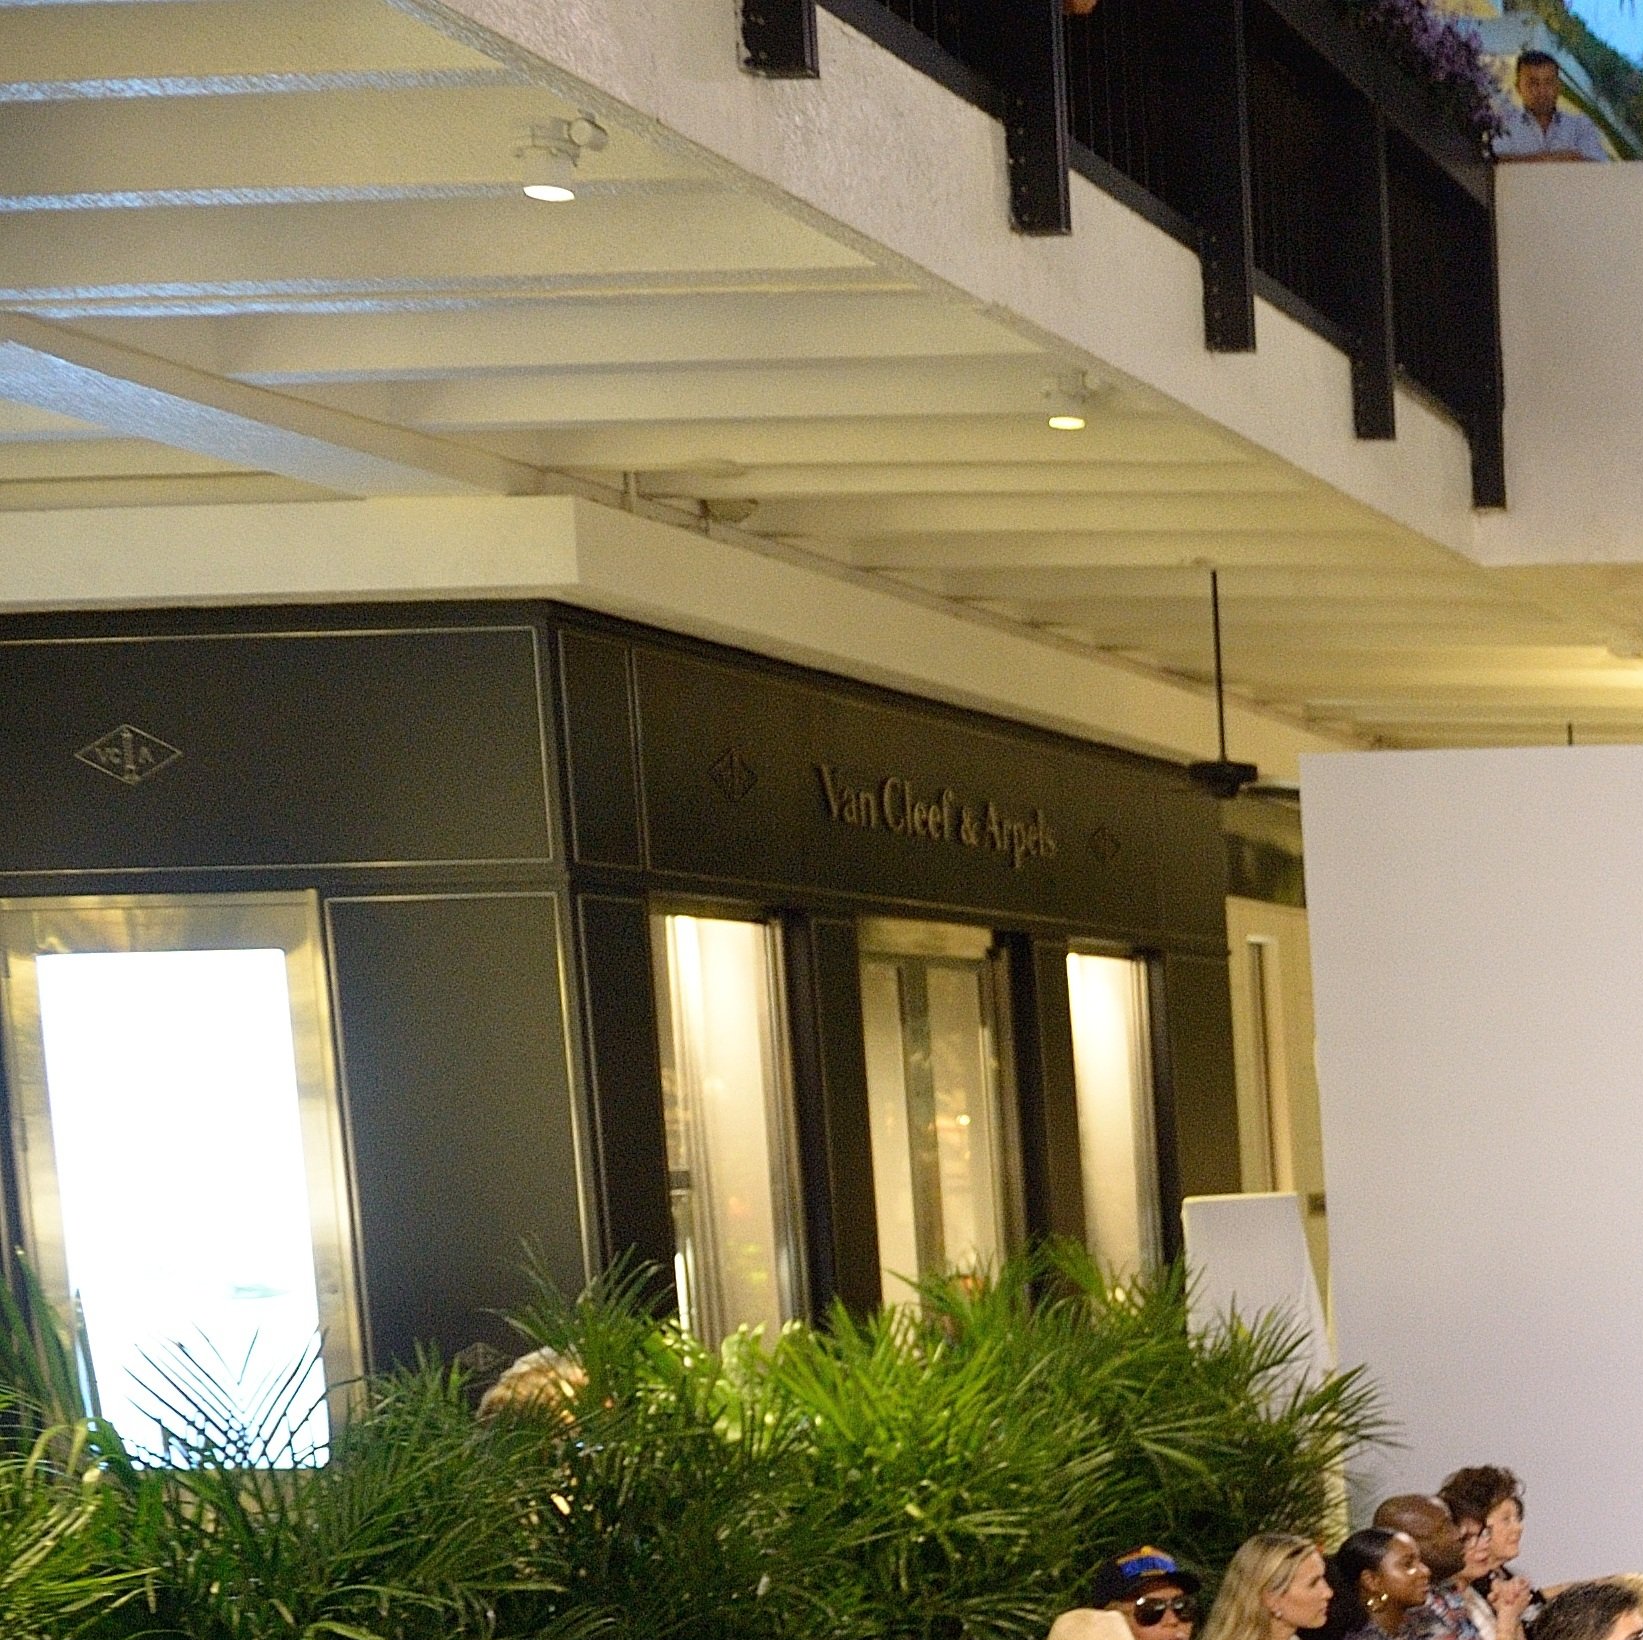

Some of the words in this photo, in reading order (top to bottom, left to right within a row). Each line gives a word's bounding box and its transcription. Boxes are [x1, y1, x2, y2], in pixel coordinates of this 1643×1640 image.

[816, 762, 878, 830] Van
[880, 776, 954, 841] Cleef
[960, 804, 979, 848] &
[984, 801, 1057, 869] Arpels
